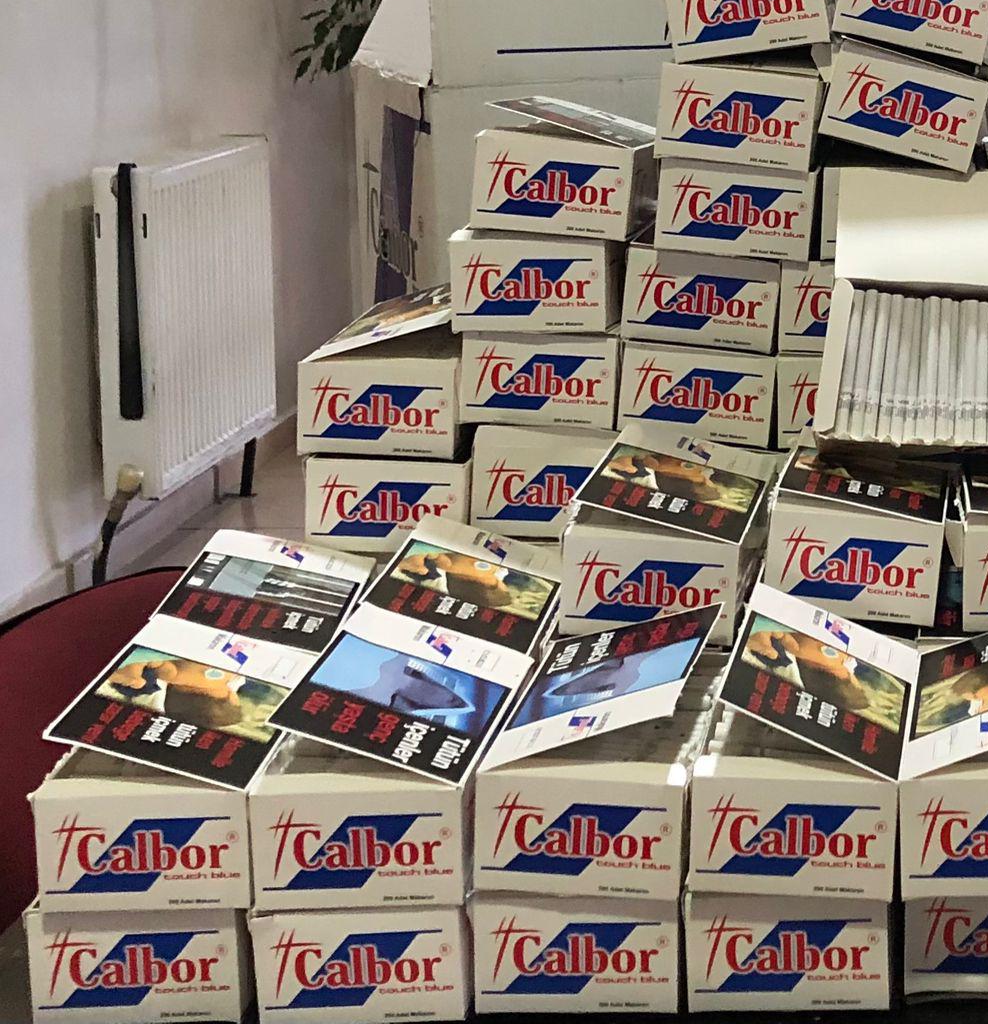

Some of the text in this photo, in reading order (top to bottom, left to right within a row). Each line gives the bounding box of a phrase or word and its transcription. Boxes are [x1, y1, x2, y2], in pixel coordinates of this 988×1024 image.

[688, 97, 799, 139] Calbor
[858, 80, 967, 135] Calbor
[503, 168, 616, 206] Calbor
[688, 191, 798, 229] Calbor
[479, 268, 591, 300] Calbor
[653, 280, 762, 319] Calbor
[491, 362, 601, 397] Calbor
[649, 374, 759, 413] Calbor
[328, 393, 440, 426] Calbor
[502, 473, 576, 507] Calb
[799, 545, 924, 588] Calbor
[594, 569, 720, 607] Calbor
[392, 721, 437, 764] içenler
[430, 734, 471, 770] Tütün
[77, 830, 229, 872] Calbor
[292, 827, 442, 869] Calbor
[514, 813, 661, 859] Calbor
[729, 815, 876, 858] Calbor
[68, 945, 219, 987] Calbor
[294, 944, 442, 987] Calbor
[512, 935, 659, 974] Calbor
[725, 932, 870, 972] Calbor
